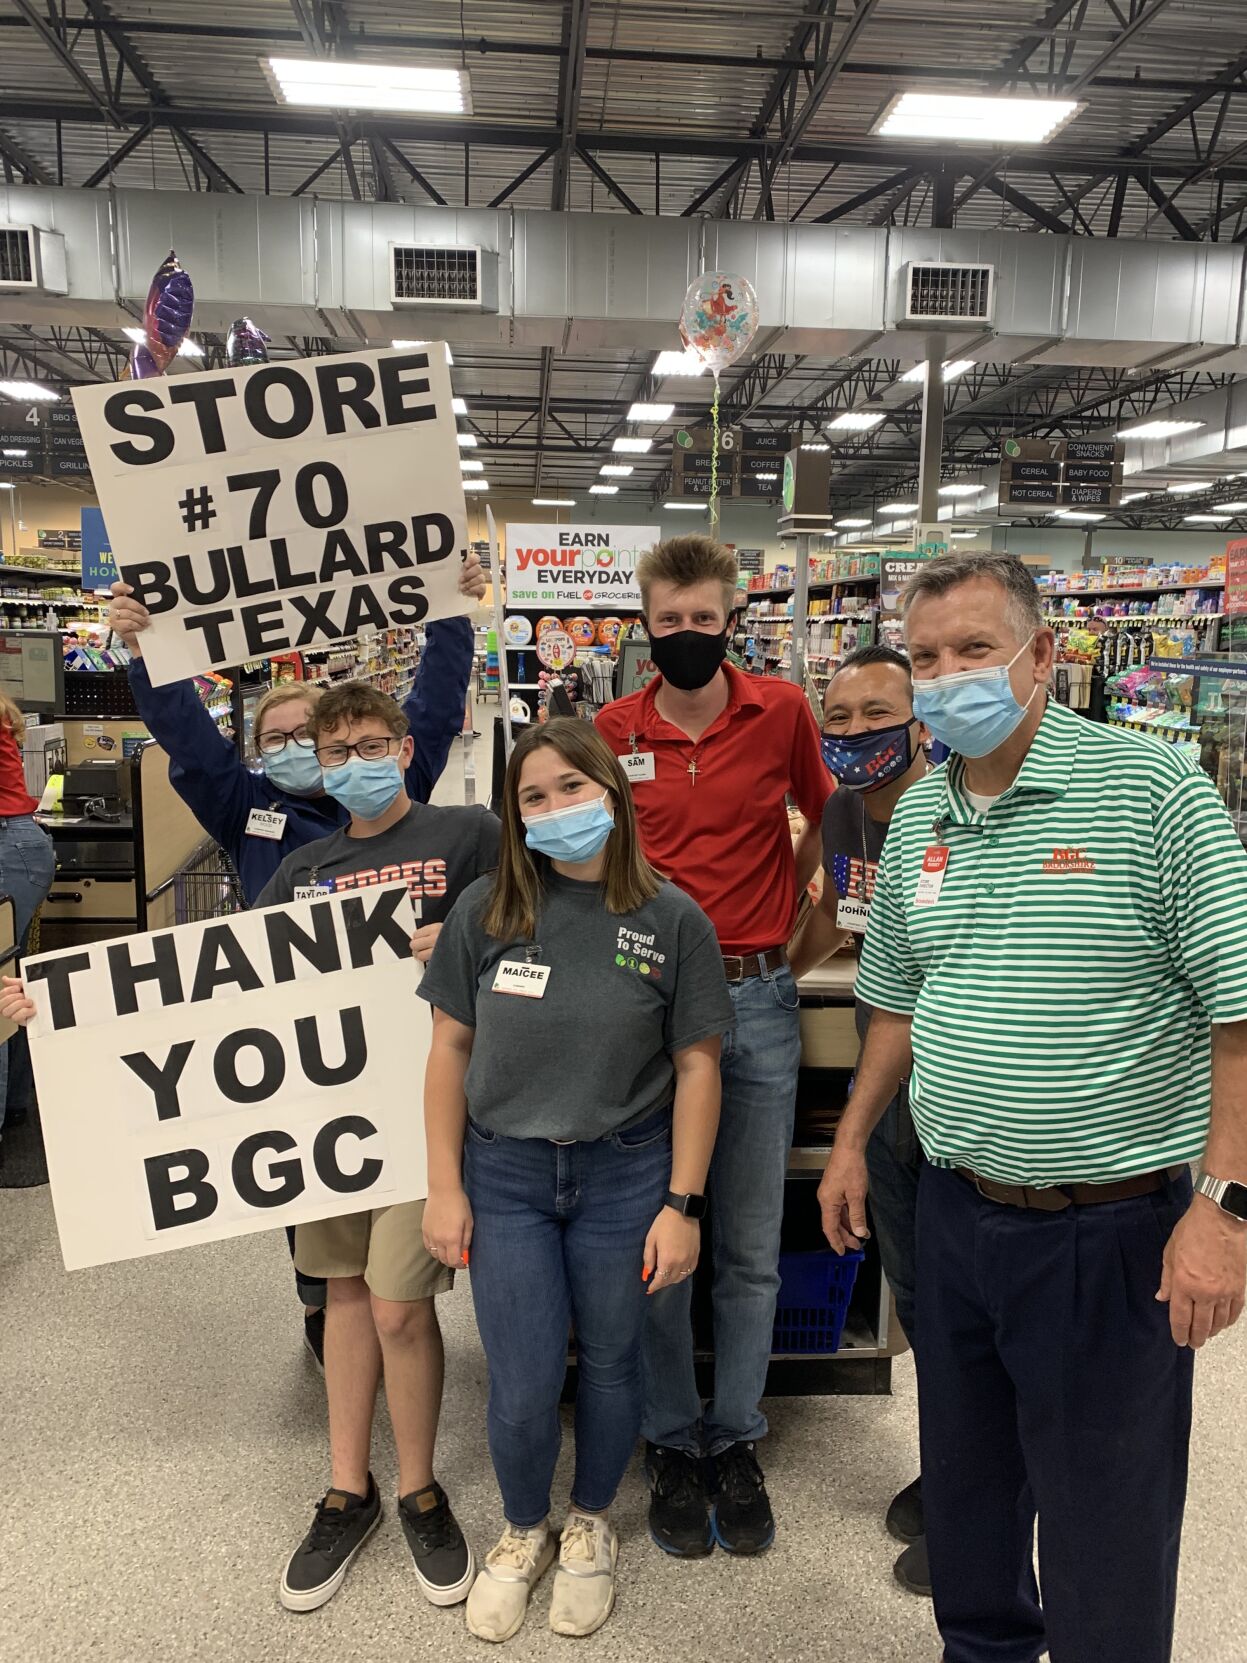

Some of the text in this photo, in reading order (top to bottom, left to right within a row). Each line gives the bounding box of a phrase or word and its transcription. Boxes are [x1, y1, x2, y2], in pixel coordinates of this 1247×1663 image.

[103, 353, 437, 466] STORE
[25, 406, 41, 426] 4
[52, 413, 70, 422] BBQ
[10, 435, 41, 444] DRESSING
[53, 438, 85, 446] CAN VEGE
[721, 431, 734, 450] 6
[1048, 440, 1061, 459] 7
[1068, 443, 1114, 452] CONVENIENT
[1076, 450, 1105, 458] SNACKS
[695, 459, 721, 467] BRED
[750, 461, 781, 469] COFFEE
[1020, 467, 1049, 476] CEREAL
[1068, 469, 1110, 477] BABY FOOD
[684, 477, 731, 486] PEANUT BTTER
[757, 483, 772, 491] TEA
[1012, 489, 1054, 498] HOT CEREAL
[1071, 488, 1102, 496] DIAPERS
[1078, 494, 1101, 502] WIPES
[57, 530, 64, 539] 2
[558, 532, 610, 547] EARN
[537, 569, 634, 585] EVERYDAY
[512, 589, 538, 599] save
[541, 589, 555, 599] on
[556, 590, 582, 600] FUEL
[594, 591, 641, 600] GROCERIE
[183, 576, 429, 664] TEXAS
[627, 758, 645, 767] SAM
[251, 812, 284, 825] KELSEY
[617, 926, 656, 946] Proud
[616, 938, 666, 964] To Serve
[25, 886, 414, 1031] THANK
[502, 967, 545, 980] MAICEE
[120, 1005, 368, 1121] YOU
[143, 1115, 384, 1231] BGC
